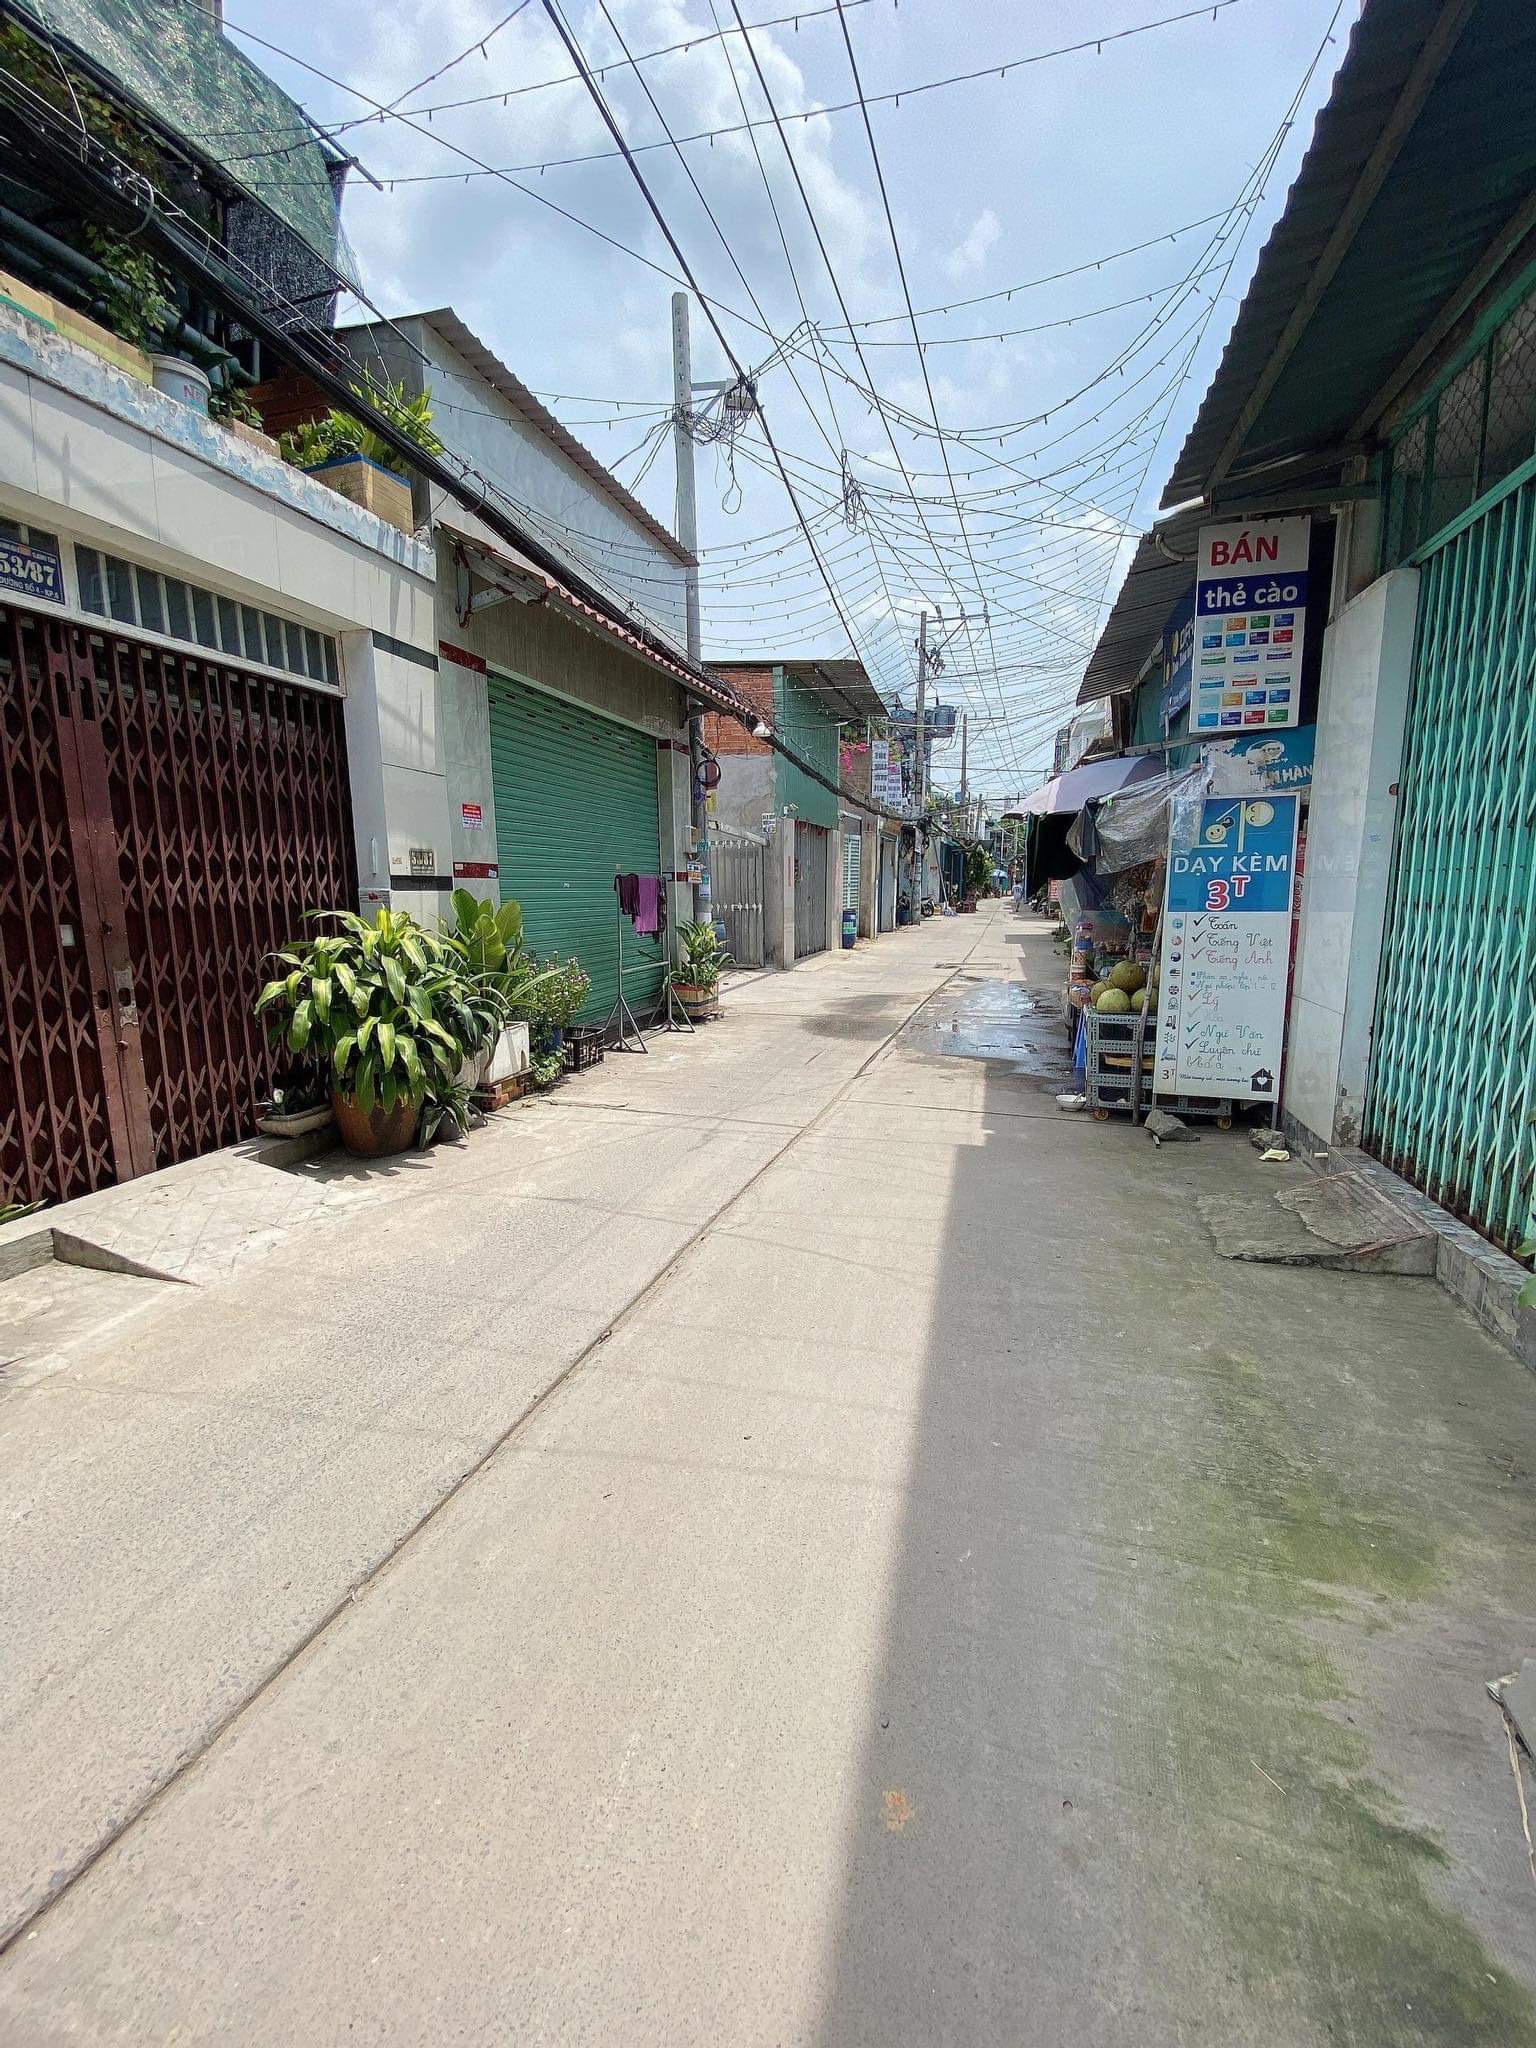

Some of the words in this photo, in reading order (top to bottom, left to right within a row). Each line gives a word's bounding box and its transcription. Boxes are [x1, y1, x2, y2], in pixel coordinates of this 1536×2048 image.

[1211, 531, 1279, 567] BÁN
[0, 552, 56, 587] 53/87
[1205, 583, 1247, 608] thẻ
[1254, 581, 1298, 604] cào
[1174, 856, 1224, 876] DẠY
[1232, 852, 1288, 872] KÈM
[1206, 875, 1251, 911] 3T
[1208, 916, 1238, 930] Toán
[1206, 932, 1239, 953] Tiếng
[1245, 933, 1273, 947] Việt
[1244, 950, 1273, 965] Anh
